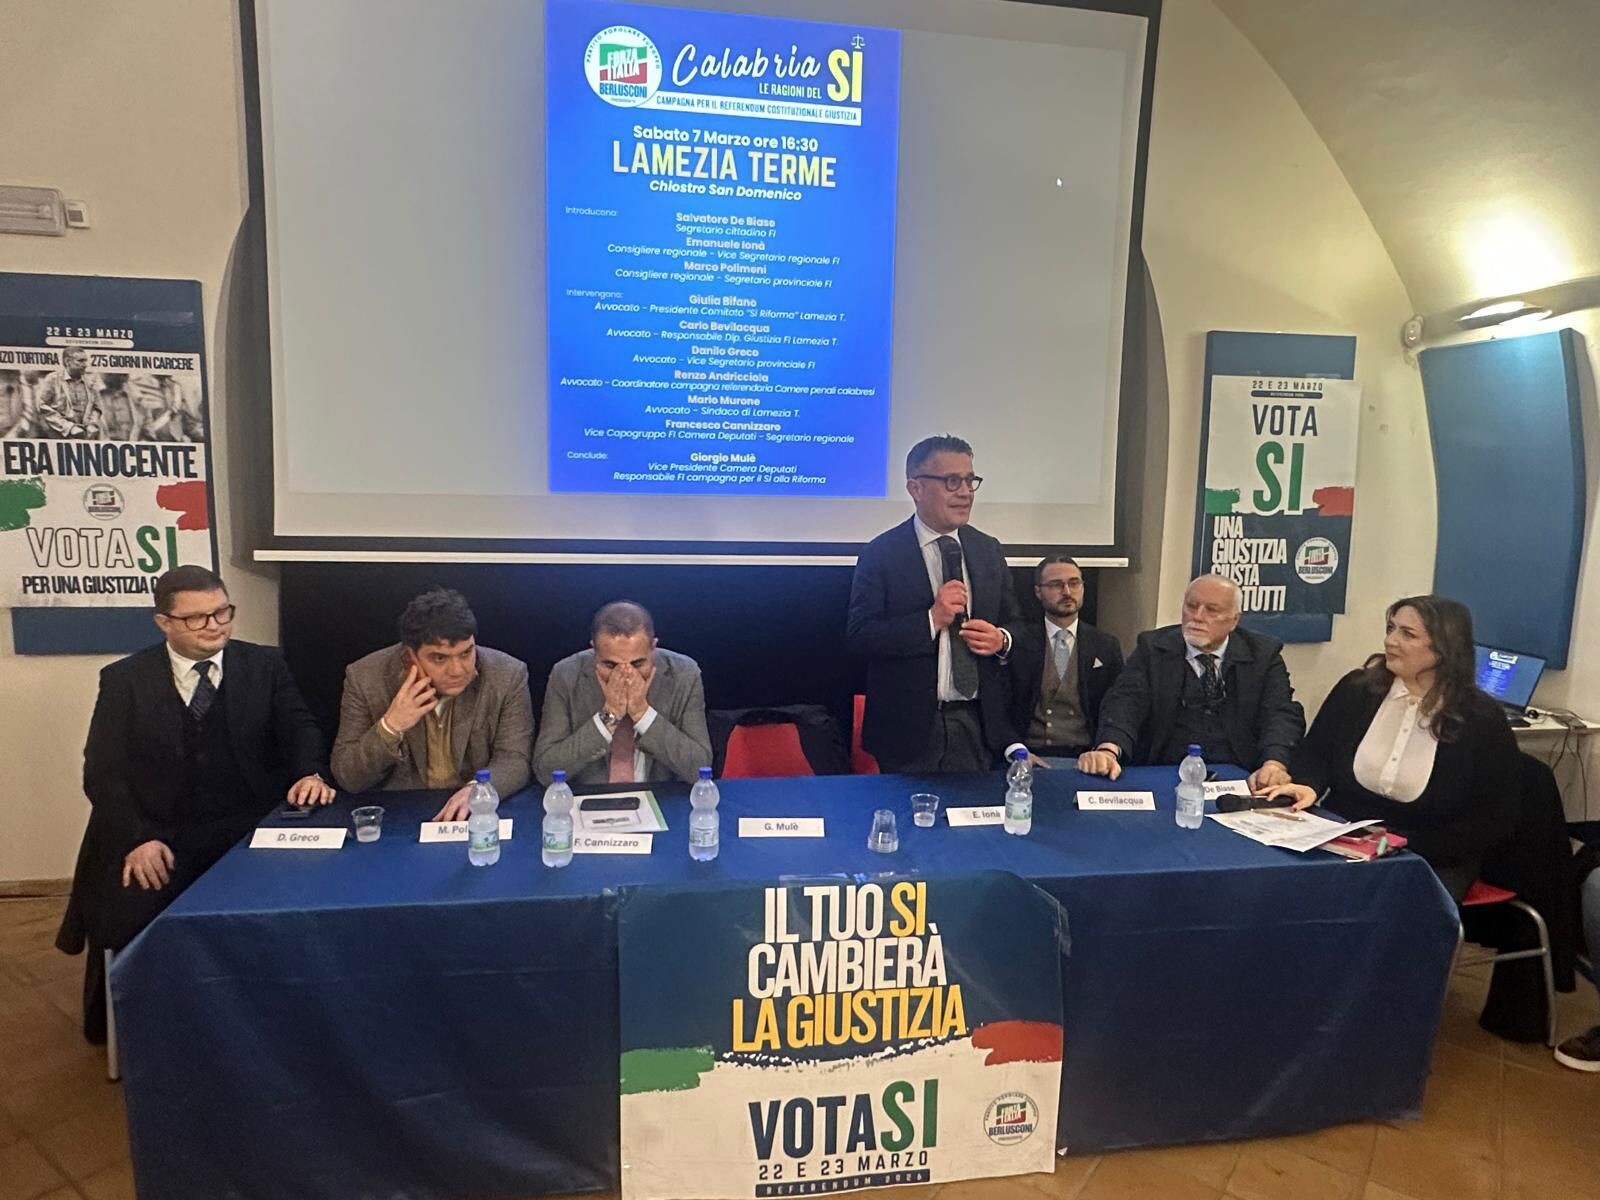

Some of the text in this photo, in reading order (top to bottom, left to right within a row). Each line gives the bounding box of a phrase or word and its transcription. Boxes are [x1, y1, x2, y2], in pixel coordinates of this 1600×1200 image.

[672, 44, 821, 87] Calabria
[599, 83, 647, 98] BERLUSCONI
[759, 82, 822, 99] LE RAGIONI DEL
[656, 96, 857, 121] CAMPAGNA PER IL REFERENDUM COSTITUZIONALE GIUSTIZIA
[633, 125, 819, 152] Sabato 7 Marzo ore 16:30
[613, 141, 837, 188] LAMEZIA TERME
[650, 180, 802, 201] Chiostro San Domenico
[675, 212, 729, 224] Salvatore
[730, 216, 745, 225] De
[675, 224, 767, 238] Segretario cittadino
[686, 237, 740, 249] Emanuele
[607, 244, 831, 266] Consigliere regionale Vice Segretario regionale
[684, 261, 767, 274] Marco Polimeni
[615, 268, 823, 288] Consigliere regionale Segretario provinciale
[689, 295, 757, 307] Giulia Bifano
[594, 302, 640, 312] Avvocato
[649, 304, 699, 315] Presidente
[700, 307, 744, 317] Comitato
[800, 312, 837, 321] Lamezia
[46, 327, 134, 339] 22 E 23 MARZO
[679, 320, 770, 334] Carlo Bevilacqua
[607, 328, 830, 346] Avvocato Responsabile Giustizia Lamezia
[0, 351, 60, 366] ZO TORTORA
[691, 345, 759, 357] Danilo Greco
[91, 355, 194, 370] 275 GIORNI IN CARCERE
[633, 354, 806, 370] Avvocato Vice Segretario provinciale
[674, 370, 707, 380] Renzo
[560, 377, 603, 387] Avvocato
[611, 379, 669, 389] Coordinatore
[671, 381, 720, 392] campagna
[811, 386, 837, 397] penali
[1252, 380, 1323, 391] 22 E 23 MARZO
[687, 395, 760, 406] Mario Murone
[645, 405, 792, 418] Avvocato Sindaco di Lamezia
[665, 420, 781, 432] Francesco Cannizzaro
[1252, 404, 1318, 436] VOTA
[584, 428, 855, 445] Vice Capogruppo Camera Deputati Segretario regionale
[3, 441, 198, 478] ERA INNOCENTE
[690, 452, 756, 464] Giorgio Mulè
[648, 462, 798, 476] Vice Presidente Camera Deputati
[1253, 441, 1305, 512] SI
[613, 472, 826, 485] Responsabile campagna per alla Riforma
[1213, 516, 1243, 539] UNA
[1212, 538, 1287, 564] GIUSTIZIA
[22, 576, 49, 594] PER
[52, 577, 80, 594] UNA
[82, 577, 151, 595] GIUSTIZIA
[1242, 585, 1286, 612] TUTTI
[1205, 786, 1214, 794] De
[1088, 795, 1144, 807] C. Bevilacqua
[972, 811, 980, 819] E.
[438, 826, 450, 834] M.
[764, 822, 799, 831] G. Mulè
[277, 833, 320, 842] D. Greco
[585, 838, 639, 848] Cannizzaro
[764, 881, 927, 944] IL TUO SI
[748, 923, 947, 999] CAMBIERÀ
[731, 985, 966, 1052] LA GIUSTIZIA
[989, 1124, 1032, 1136] BERLUSCONI
[759, 1150, 928, 1180] 22 E 23 MARZO
[766, 1173, 922, 1195] REFERENDUM 2026
